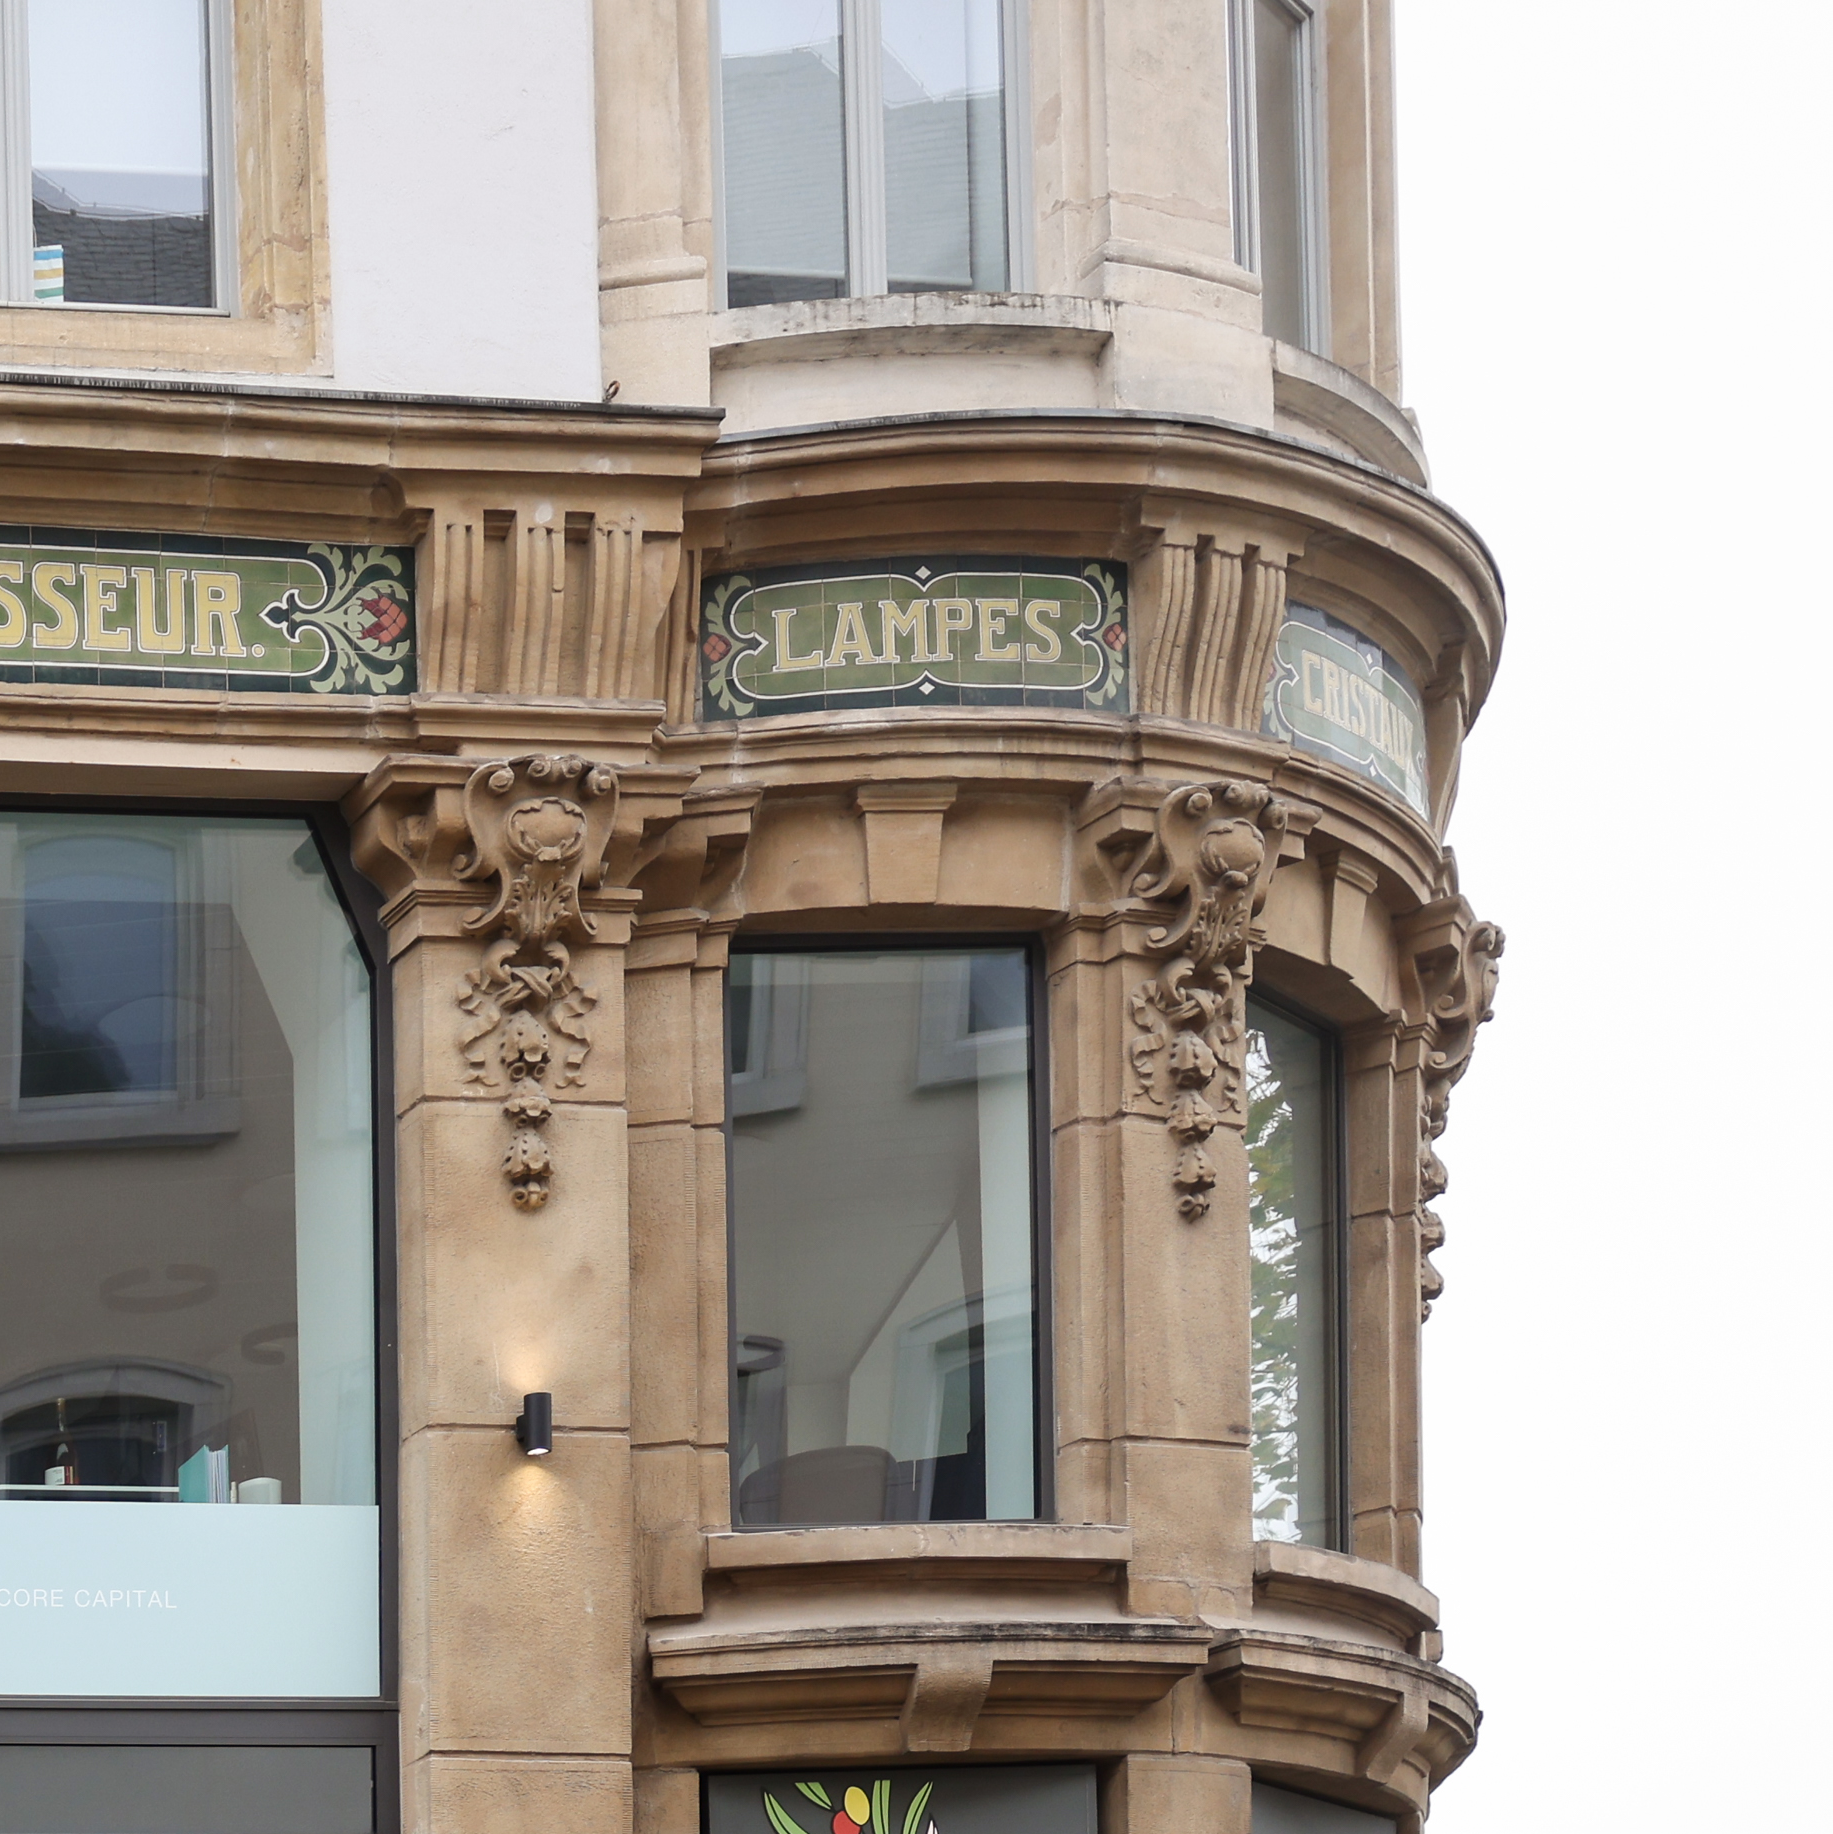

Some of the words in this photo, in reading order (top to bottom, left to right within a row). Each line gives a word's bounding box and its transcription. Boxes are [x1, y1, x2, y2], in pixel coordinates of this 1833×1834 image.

[771, 597, 1063, 674] LAMPES
[1301, 649, 1414, 774] CRISTAUX
[74, 1587, 178, 1610] CAPITAL
